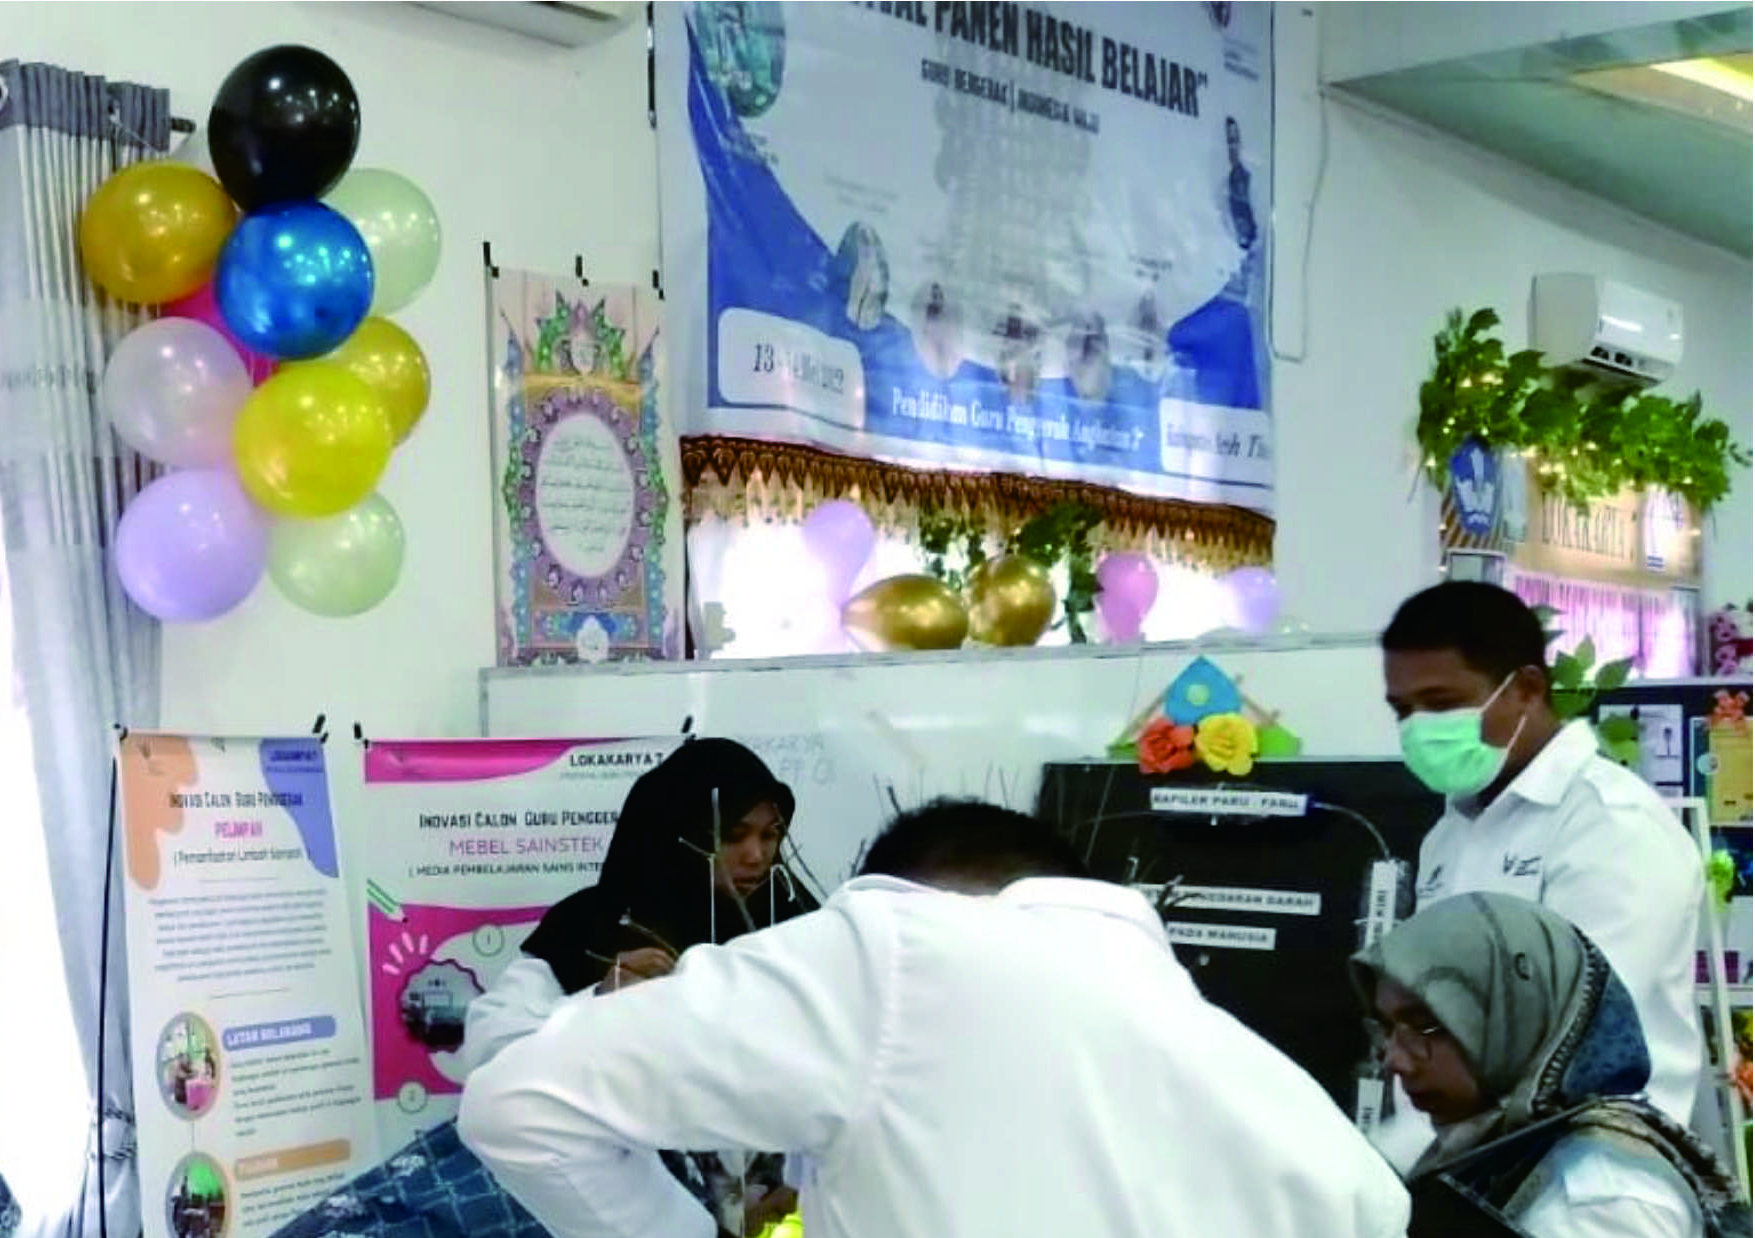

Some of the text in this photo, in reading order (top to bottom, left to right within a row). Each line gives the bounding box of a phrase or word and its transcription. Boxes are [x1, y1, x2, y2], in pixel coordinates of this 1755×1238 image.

[934, 0, 1019, 58] PANEN
[1025, 9, 1097, 84] HASIL
[753, 342, 775, 374] 13
[570, 752, 653, 767] LOKAKARYA
[419, 811, 558, 829] INOVASI CALON GURU
[449, 835, 604, 856] MEBEL SAINSTEK
[453, 862, 540, 877] PEMBELAJARAN
